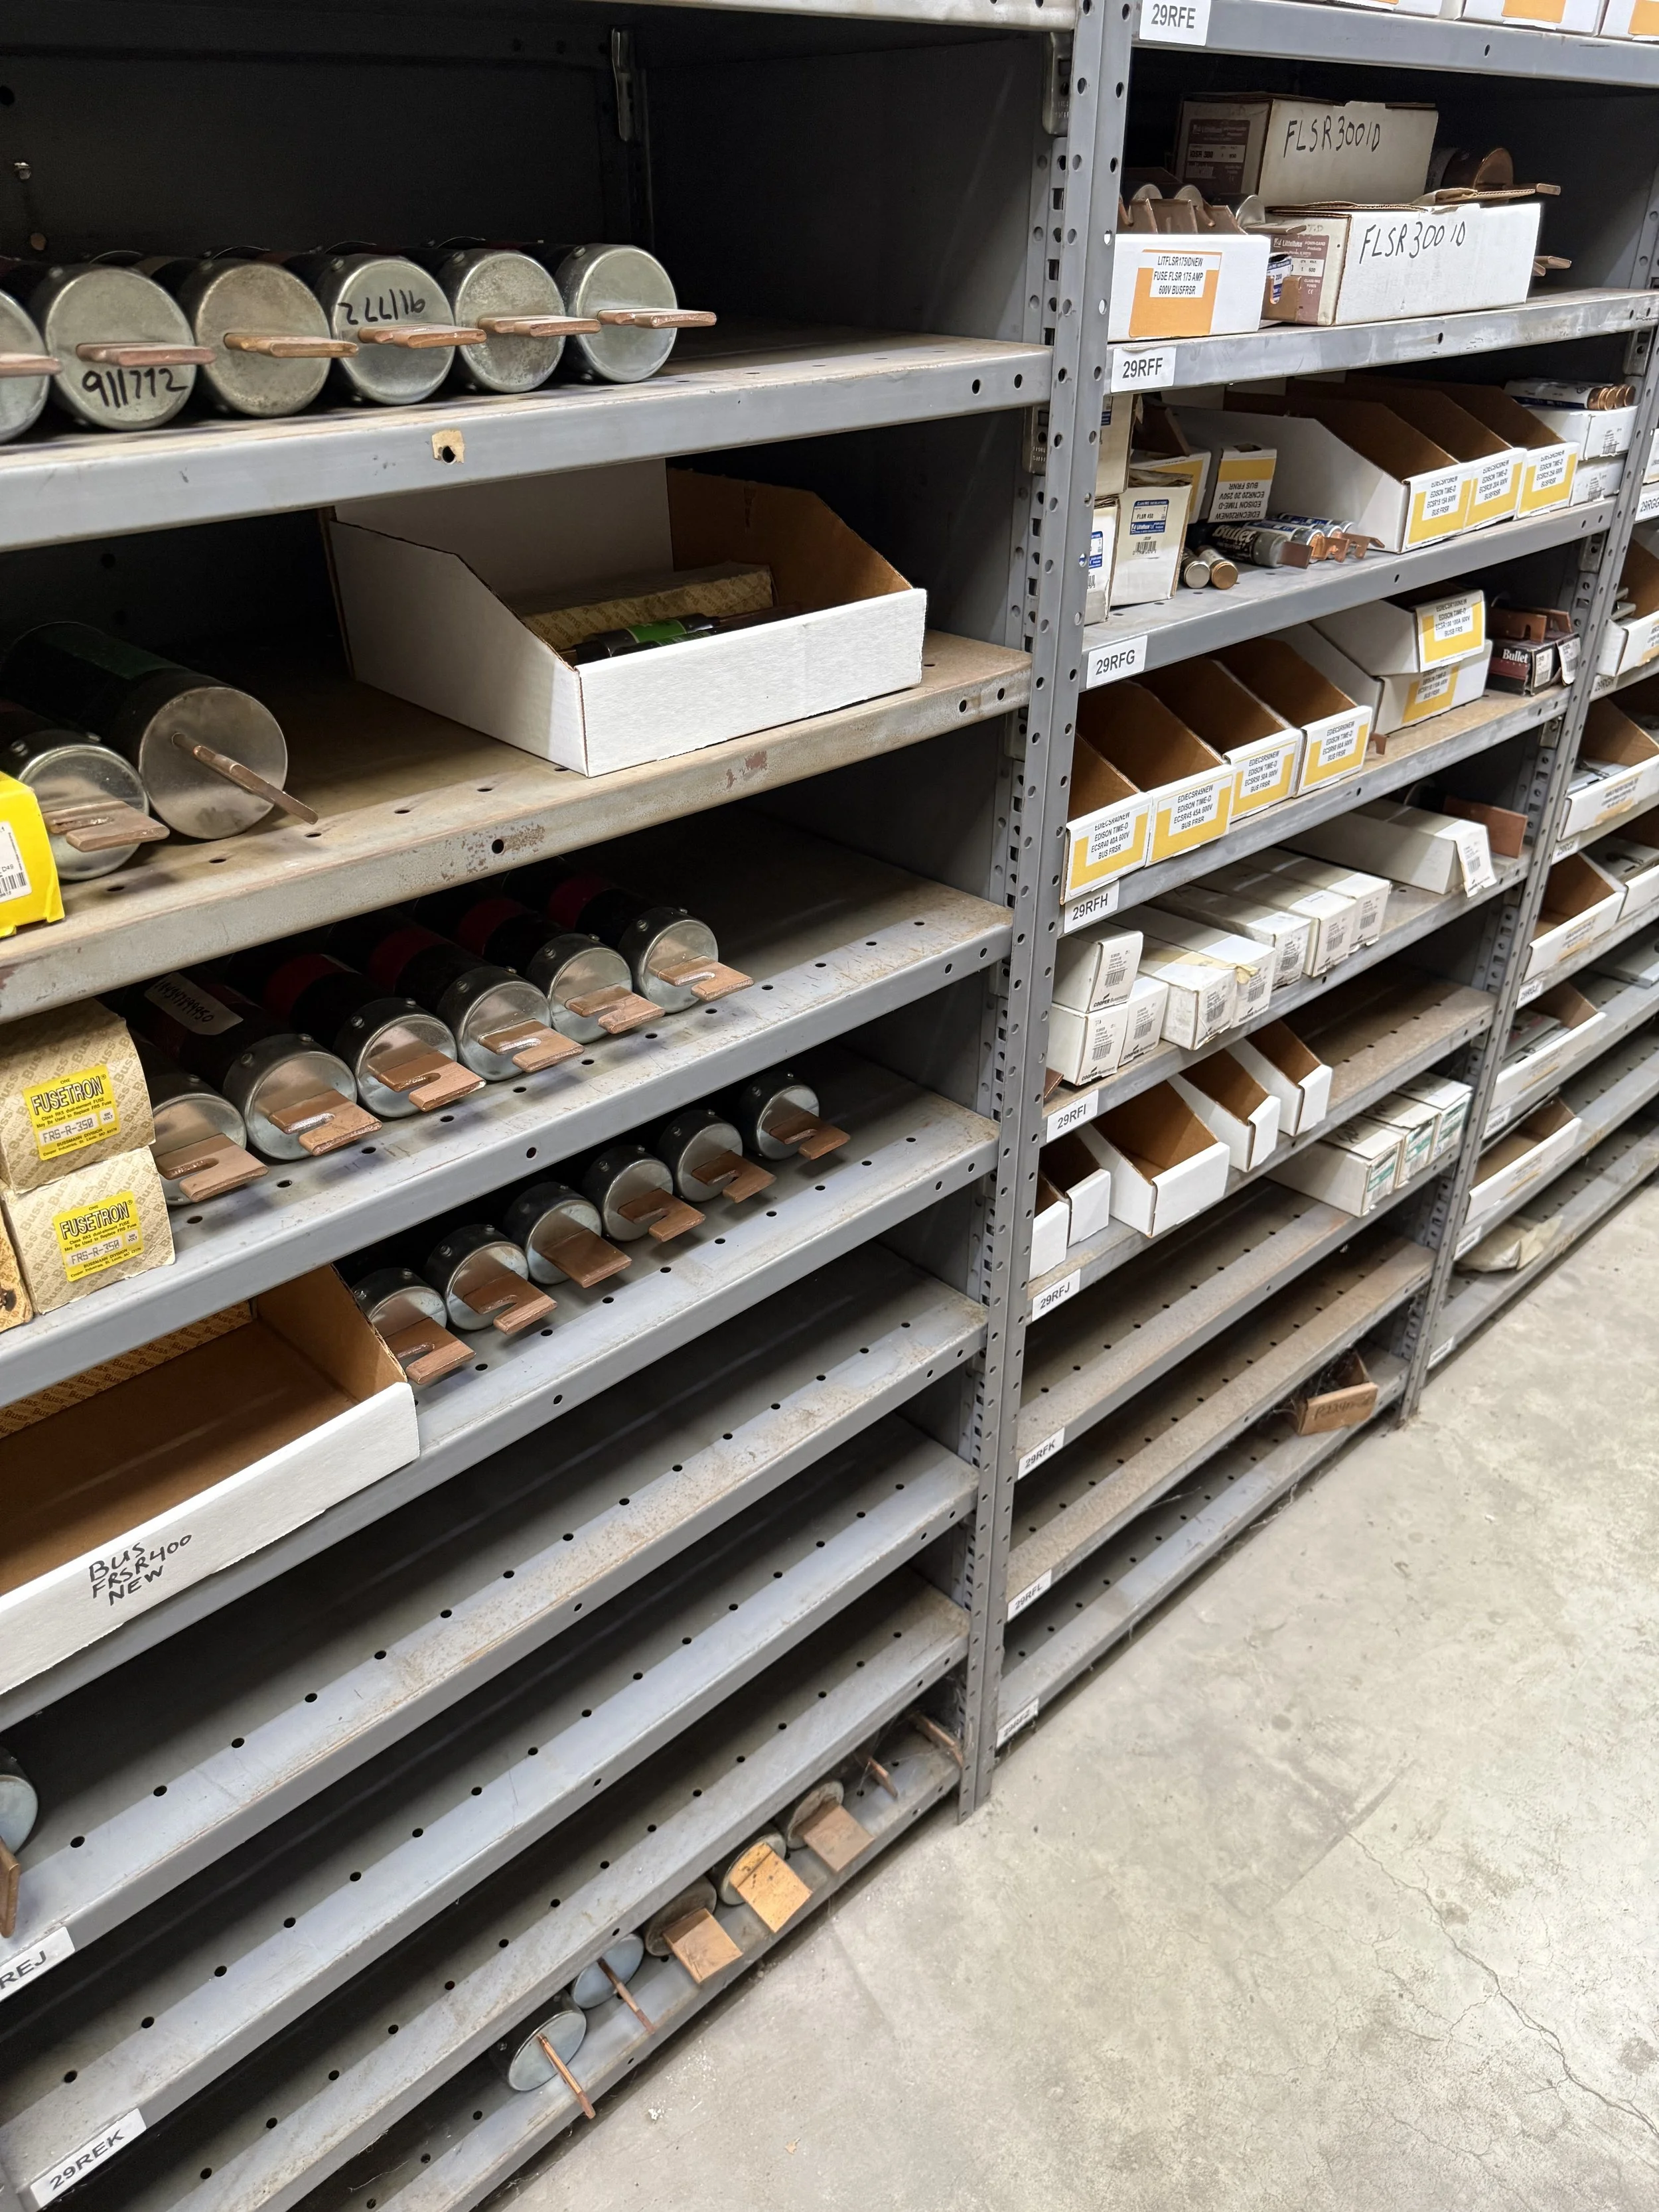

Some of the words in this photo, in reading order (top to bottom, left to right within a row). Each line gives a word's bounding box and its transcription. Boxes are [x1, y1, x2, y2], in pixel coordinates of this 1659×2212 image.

[1151, 3, 1196, 29] 29RFE
[1153, 271, 1168, 281] FUSE
[1168, 271, 1182, 281] FLSR
[1183, 272, 1191, 281] 175
[1192, 272, 1204, 281] AMP
[1159, 285, 1171, 295] 600V
[1171, 285, 1196, 295] BUSFRSR
[1122, 357, 1163, 379] 29RFF
[1096, 649, 1135, 676] 29RFG
[1502, 648, 1529, 664] Bullet
[1326, 735, 1340, 746] EDISON
[1340, 730, 1353, 741] TIME-D
[1335, 749, 1346, 759] FRSR
[1248, 766, 1264, 777] EDISON
[1263, 760, 1277, 771] TIME-D
[1250, 784, 1259, 792] BUS
[1259, 780, 1270, 790] FRSR
[1173, 812, 1192, 824] ECSR45
[1192, 808, 1201, 819] 45A
[1202, 803, 1213, 815] 600V
[1177, 800, 1195, 814] EDISON
[1194, 794, 1212, 808] TIME-D
[1094, 828, 1112, 842] EDISON
[1112, 822, 1129, 834] TIME-D
[1181, 820, 1191, 830] BUS
[1191, 816, 1204, 828] FRSR
[1091, 840, 1109, 853] ECSR40
[1109, 836, 1118, 847] 40A
[1118, 832, 1129, 843] 600V
[1098, 849, 1108, 859] BUS
[1108, 844, 1121, 856] FRSR
[1072, 893, 1108, 921] 29RFH
[1093, 997, 1110, 1008] COOPER
[31, 1075, 104, 1116] FUSETRON
[1057, 1104, 1086, 1130] 29RFI
[42, 1118, 94, 1143] FRS-R-350
[56, 1136, 82, 1147] BUSSMANN
[84, 1128, 104, 1138] DIVISION
[59, 1201, 130, 1240] FUSETRON
[71, 1239, 120, 1265] FRS-R-350
[83, 1256, 108, 1268] BUSSMANN
[109, 1248, 128, 1259] DIVISION
[1040, 1282, 1070, 1309] 29RFJ
[1025, 1439, 1056, 1469] 29RFK
[88, 1542, 145, 1583] BUS
[92, 1534, 192, 1599] FRSR400
[108, 1565, 164, 1606] NEW
[1015, 1582, 1043, 1610] 29RFL
[50, 2128, 125, 2191] 29REK
